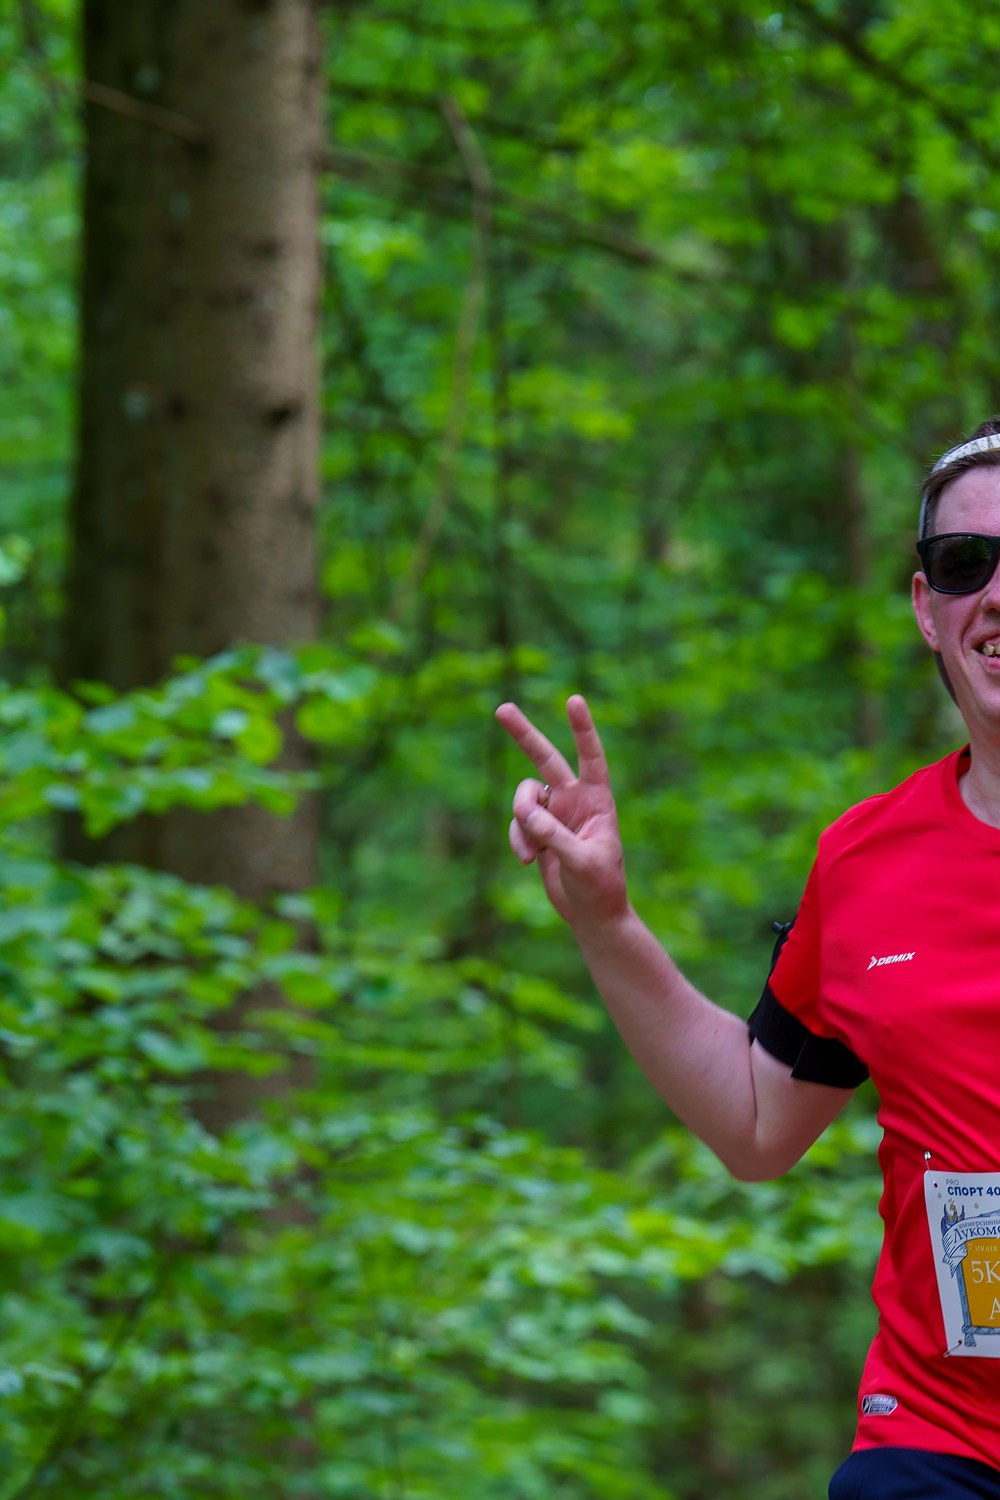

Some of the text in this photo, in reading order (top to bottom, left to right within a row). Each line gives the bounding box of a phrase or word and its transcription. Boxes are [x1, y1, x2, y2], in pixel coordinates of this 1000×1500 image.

[876, 951, 916, 966] DEMIX
[947, 1186, 984, 1197] СПОРТ
[974, 1244, 998, 1253] июня
